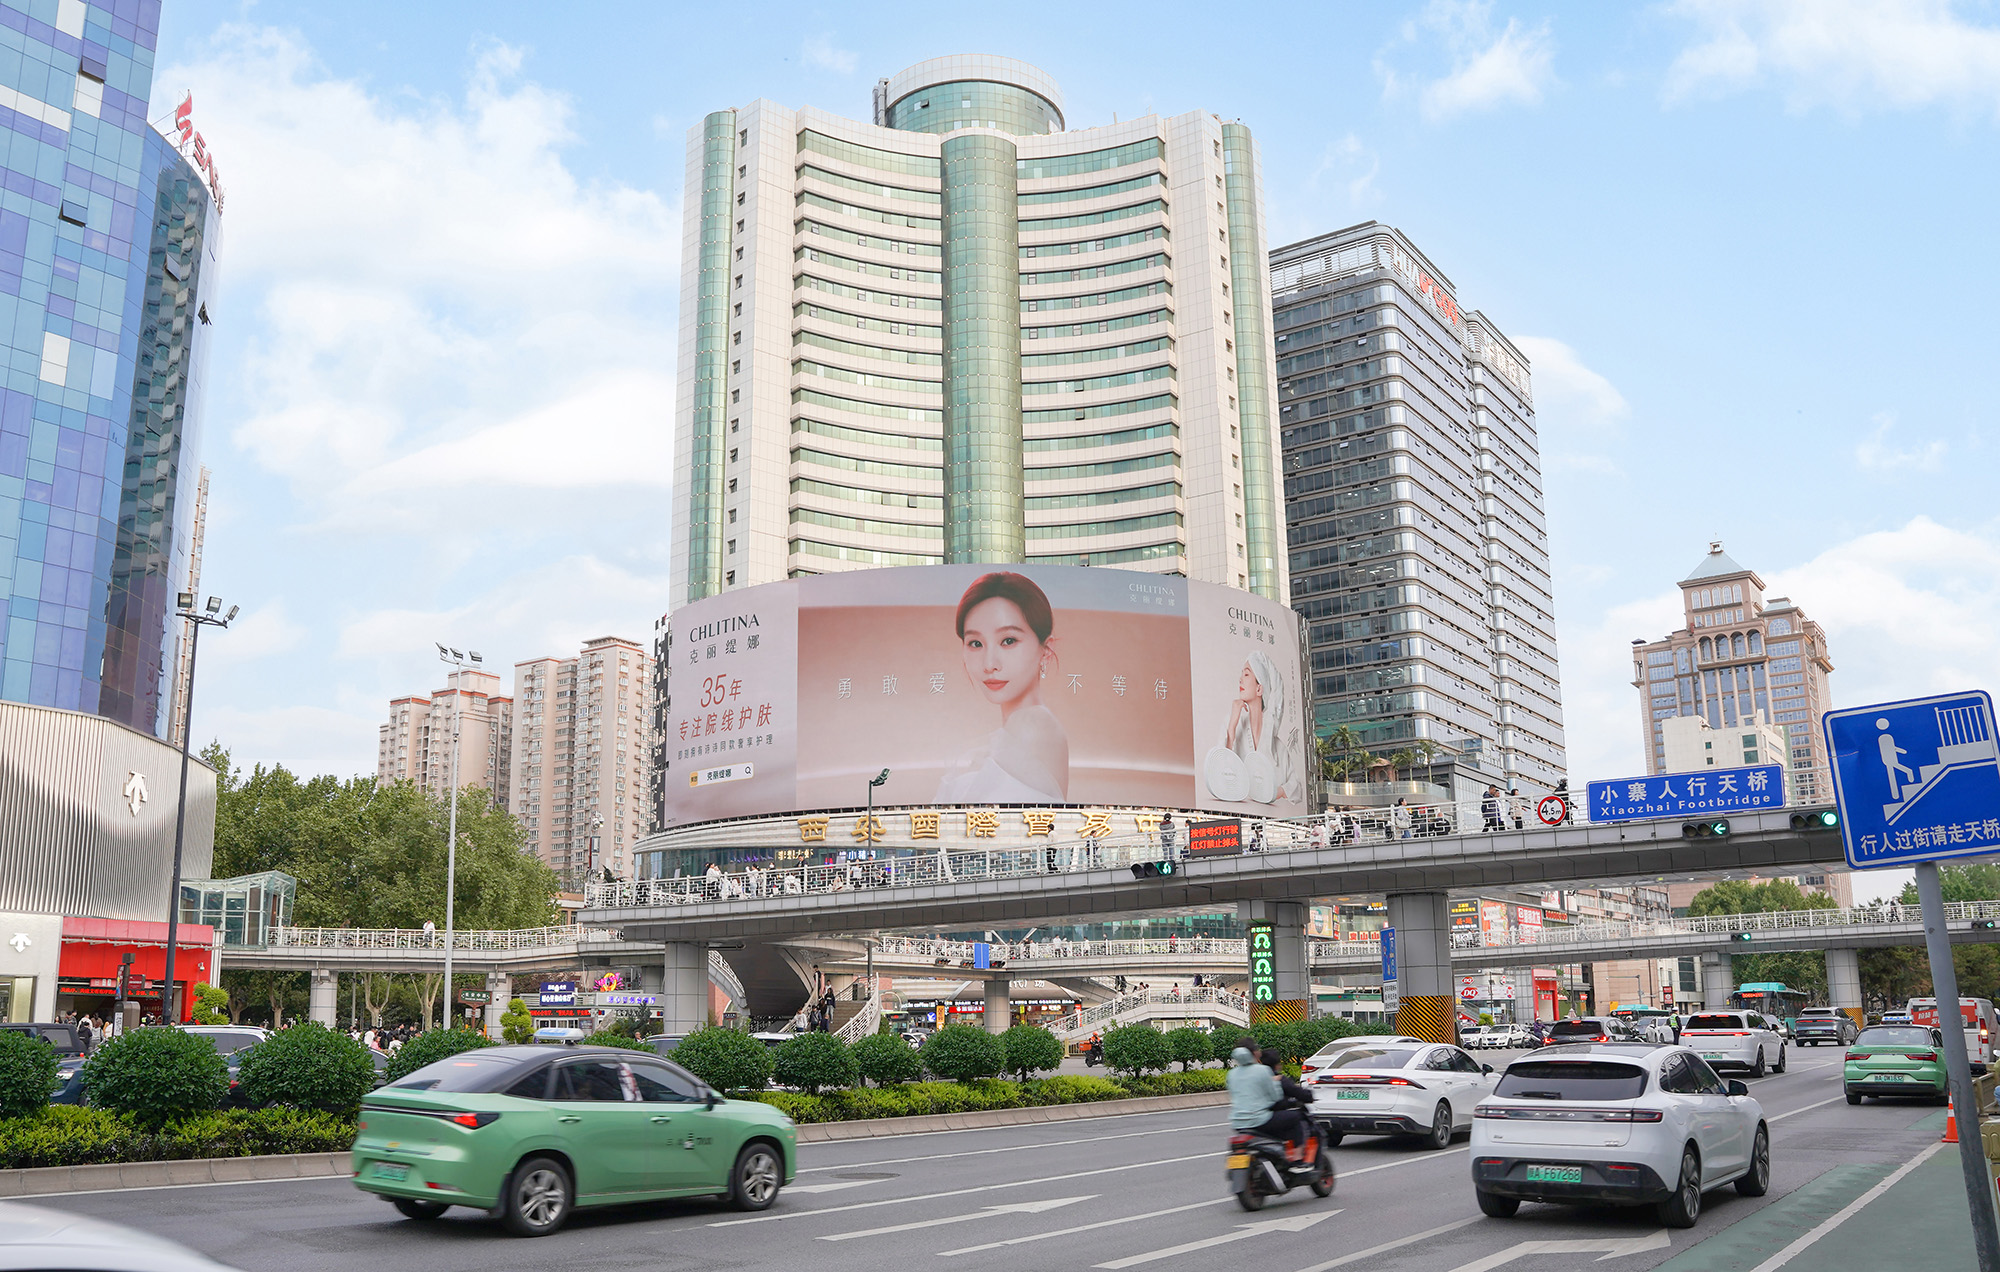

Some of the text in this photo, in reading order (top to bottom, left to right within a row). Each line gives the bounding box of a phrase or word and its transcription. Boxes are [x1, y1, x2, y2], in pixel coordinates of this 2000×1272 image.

[1128, 583, 1175, 596] CHLITINA
[689, 613, 760, 643] CHLITINA
[1227, 607, 1275, 630] CHLITINA
[1228, 623, 1275, 645] 克丽缇娜
[689, 634, 760, 665] 克丽缇娜
[700, 674, 742, 708] 35年
[679, 702, 773, 741] 专注院线护肤
[1600, 770, 1769, 804] 小寨人行天桥
[1541, 803, 1562, 816] 4.5m
[1601, 792, 1771, 817] Xiaozhai Footbridge
[1190, 824, 1239, 839] 按信号灯行驶
[1860, 817, 2000, 856] 行人过街请走天桥
[1190, 838, 1240, 851] 红灯禁止掉头
[1463, 989, 1476, 997] DQ
